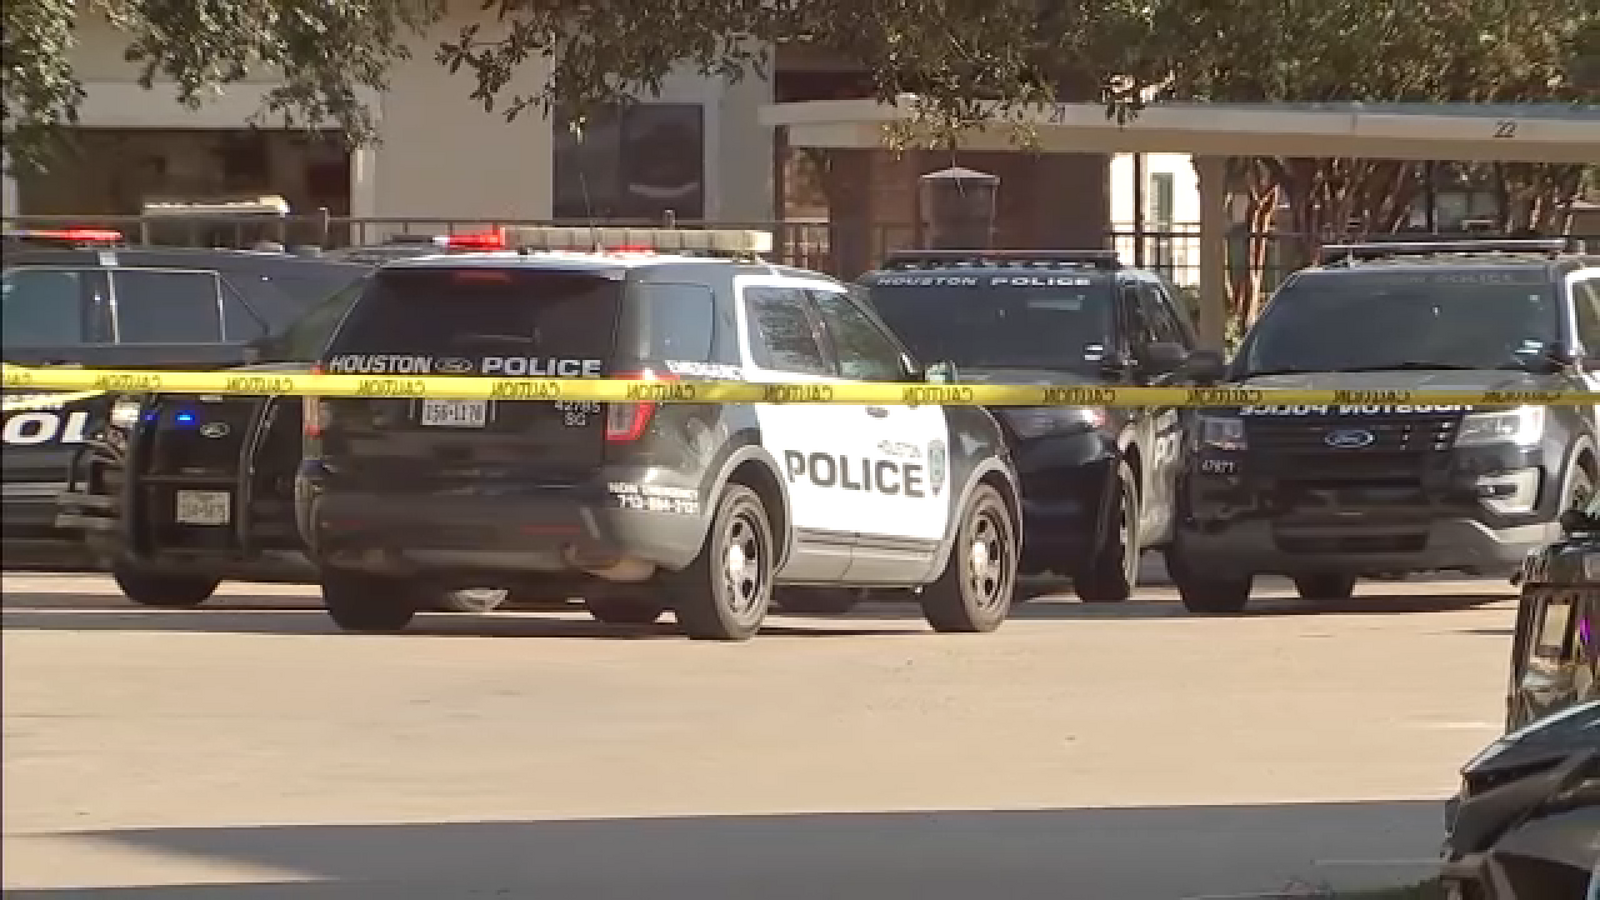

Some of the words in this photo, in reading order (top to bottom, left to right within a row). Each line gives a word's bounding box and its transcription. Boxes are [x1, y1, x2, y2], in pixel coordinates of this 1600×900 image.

[1494, 121, 1516, 138] 22
[877, 274, 977, 286] HOUSTON
[988, 275, 1089, 287] POLICE
[330, 355, 432, 374] HOUSTON
[482, 356, 601, 376] POLICE
[785, 449, 926, 498] POLICE
